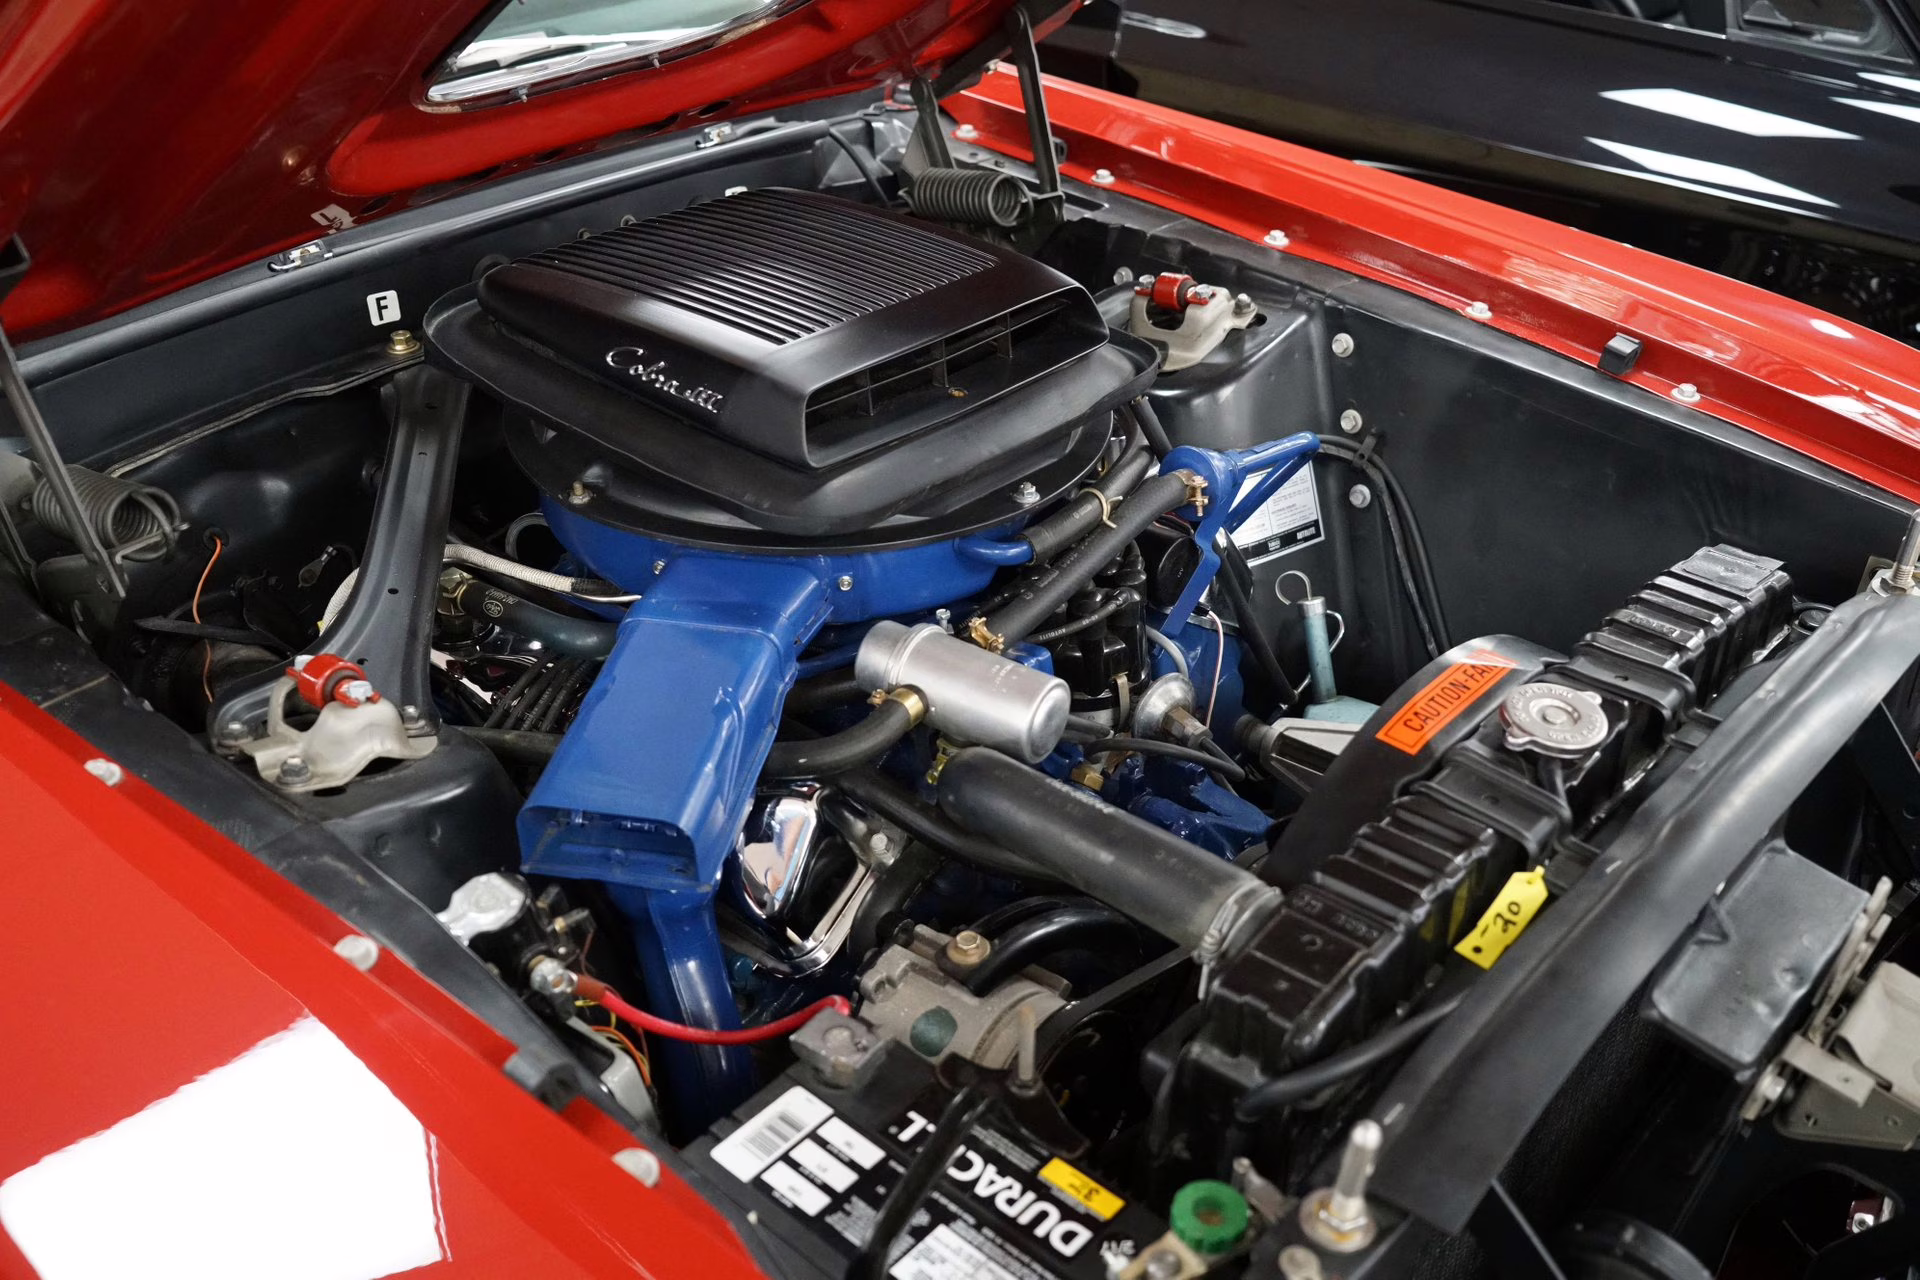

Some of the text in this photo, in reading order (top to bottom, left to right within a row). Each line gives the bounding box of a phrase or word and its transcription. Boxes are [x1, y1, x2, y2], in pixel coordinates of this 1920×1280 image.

[374, 295, 389, 322] F
[605, 346, 680, 396] Cobra
[1039, 627, 1066, 642] AUTOLITE
[897, 1109, 1094, 1258] DURACL
